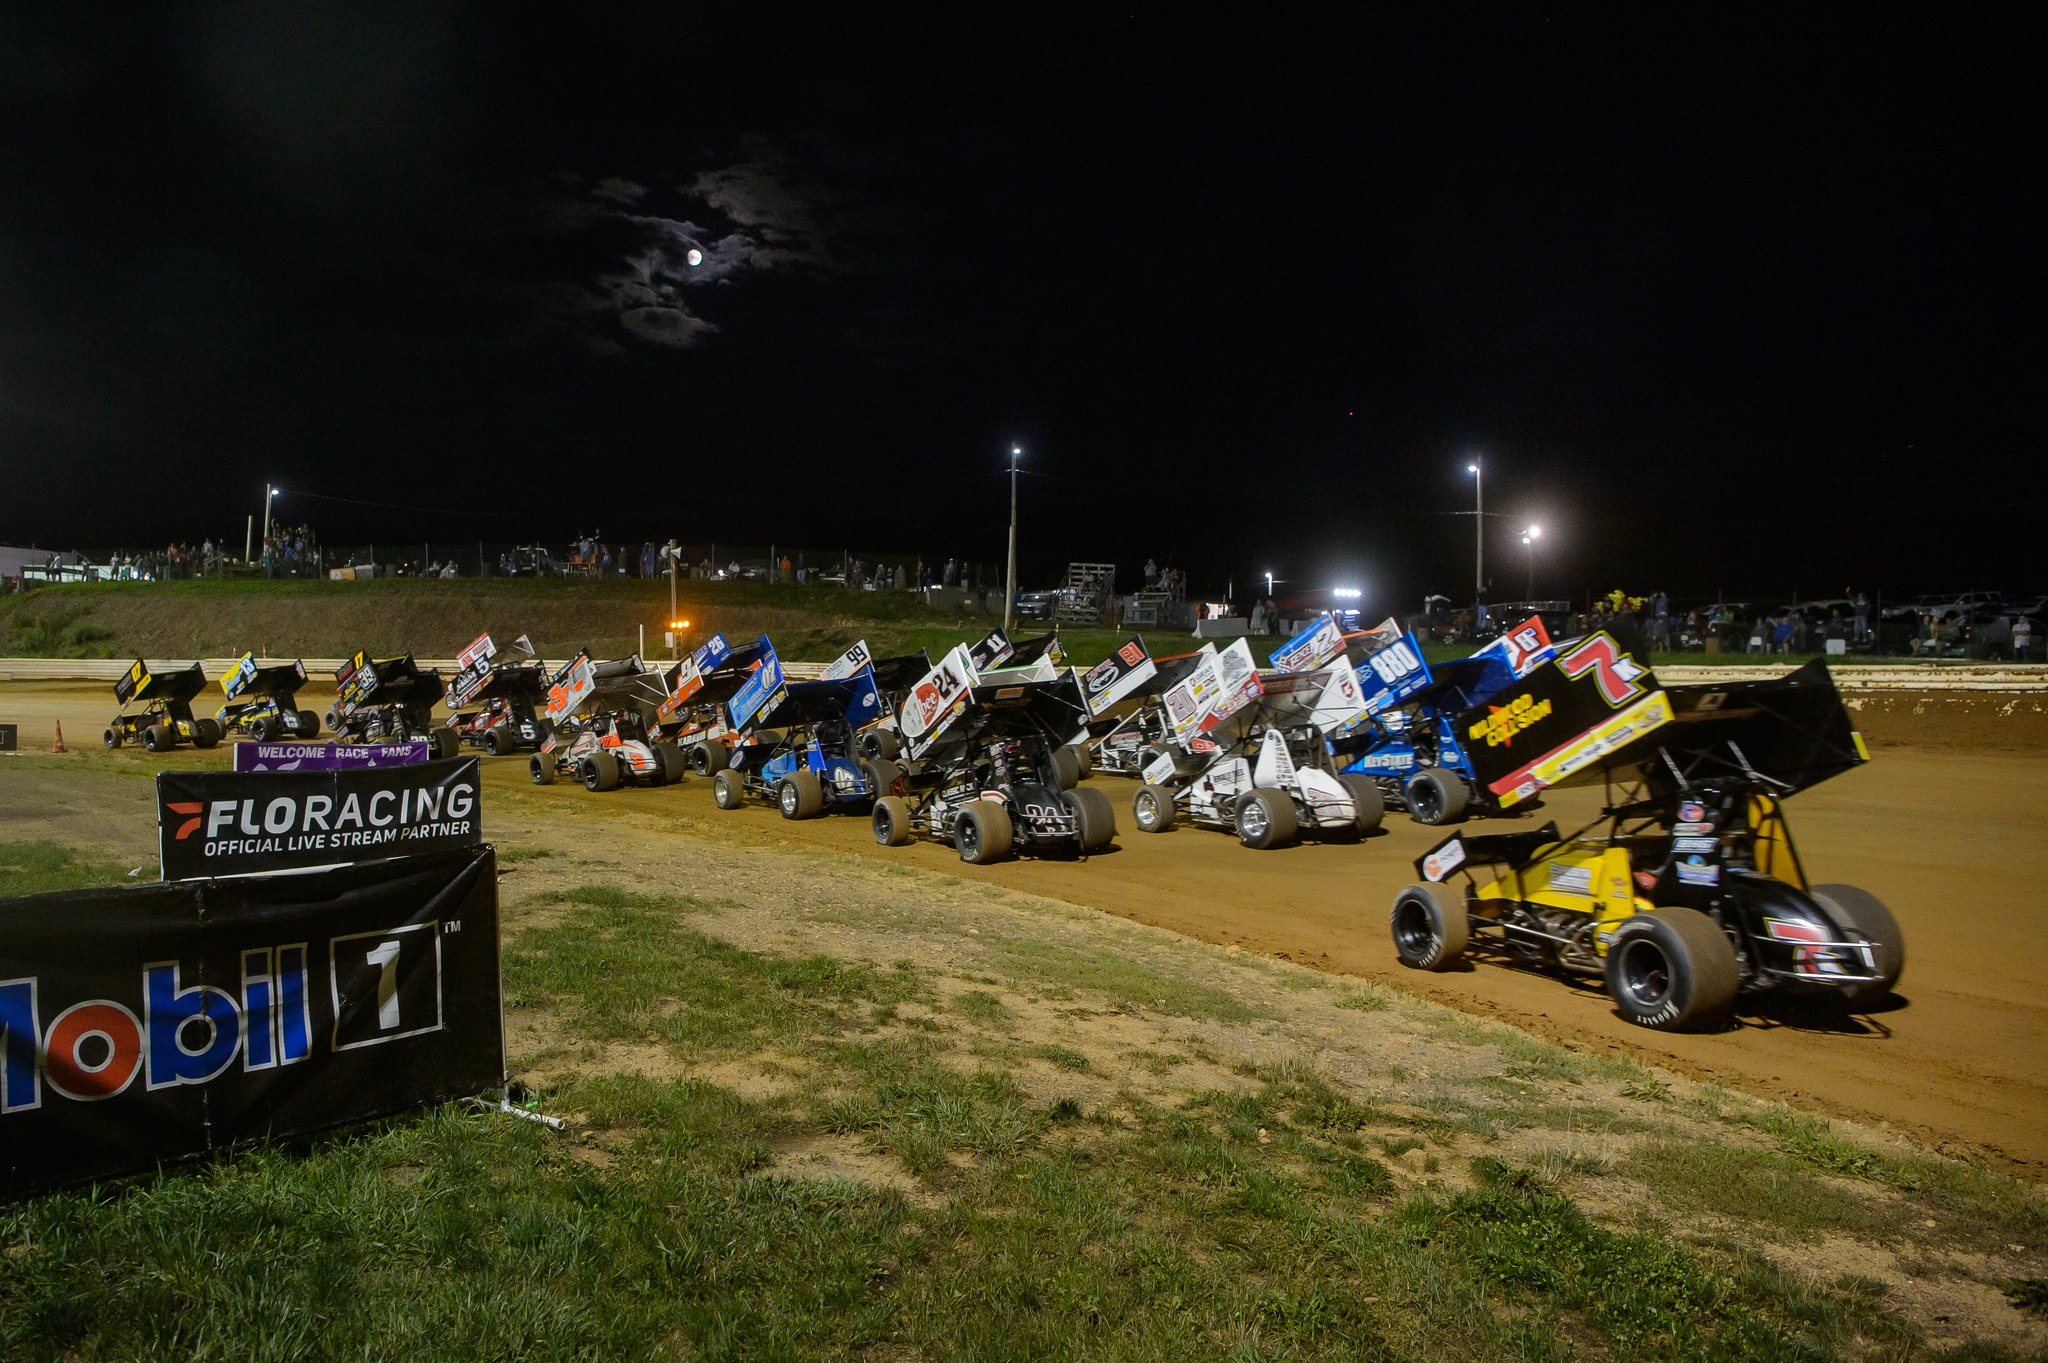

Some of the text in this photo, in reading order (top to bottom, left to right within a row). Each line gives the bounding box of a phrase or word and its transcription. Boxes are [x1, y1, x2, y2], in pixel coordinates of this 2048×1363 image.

[707, 634, 725, 656] 26
[846, 644, 868, 665] 99
[986, 633, 1007, 653] 11
[239, 657, 256, 677] 13
[475, 657, 490, 675] 5
[679, 656, 693, 686] 9
[760, 658, 778, 692] 07
[1370, 641, 1420, 685] 880
[357, 664, 377, 690] 39
[933, 664, 961, 699] 24
[520, 723, 536, 740] 5
[1486, 698, 1552, 747] COLLISION
[258, 745, 412, 759] WELCOME RACE FANS
[206, 783, 474, 838] FLORACING
[204, 821, 471, 857] OFFICIAL LIVE STREAM PARTNER
